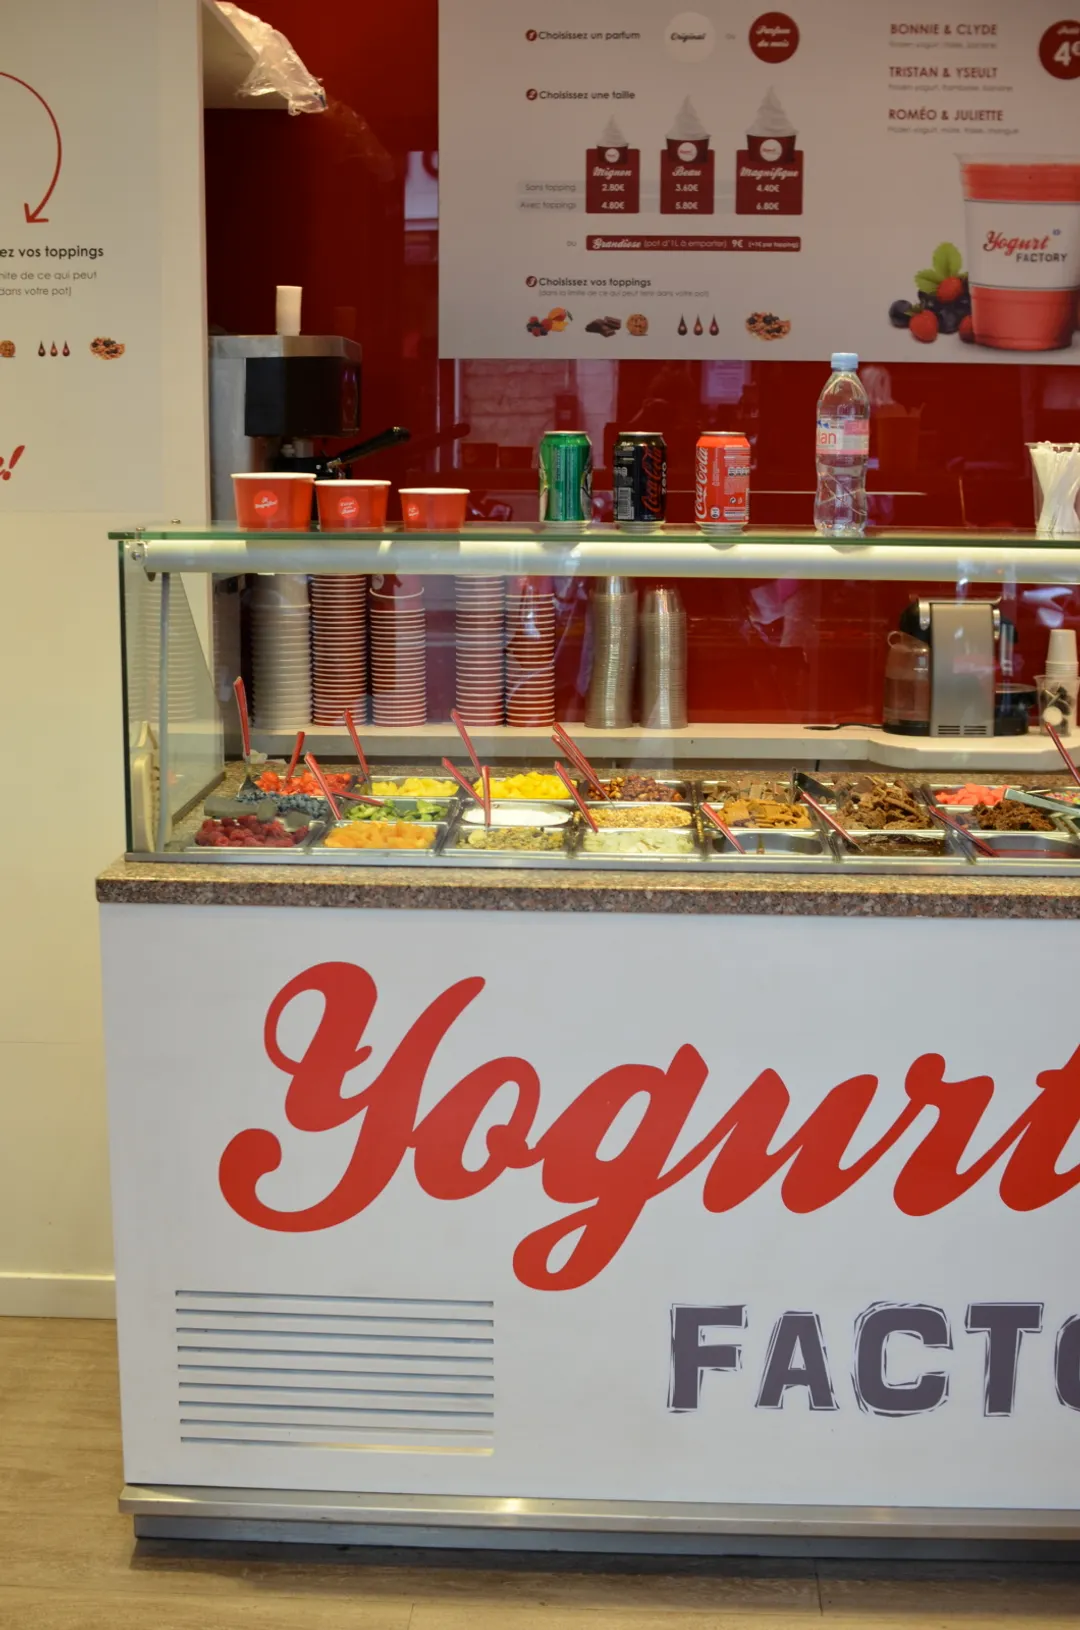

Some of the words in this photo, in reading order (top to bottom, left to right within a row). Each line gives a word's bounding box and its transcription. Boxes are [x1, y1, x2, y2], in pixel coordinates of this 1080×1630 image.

[890, 24, 940, 35] BONNIE
[944, 24, 952, 35] &
[956, 24, 998, 36] CLYDE
[538, 31, 588, 40] Choisissez
[590, 32, 603, 40] un
[605, 31, 640, 40] parfum
[670, 32, 706, 43] Original
[889, 66, 939, 78] TRISTAN
[942, 67, 951, 78] &
[956, 66, 998, 78] YSEULT
[538, 90, 588, 100] Choisissez
[590, 92, 610, 100] une
[612, 90, 636, 100] taille
[888, 106, 937, 120] ROMÉO
[941, 110, 949, 120] &
[954, 109, 1004, 120] JULIETTE
[592, 166, 633, 180] Mignon
[672, 166, 702, 176] Beau
[740, 166, 798, 180] Magnifique
[525, 184, 543, 192] Sans
[601, 183, 625, 192] 2.80€
[674, 184, 699, 192] 3.60€
[756, 184, 780, 193] 4.40€
[543, 201, 577, 210] toppings
[601, 201, 625, 210] 4.80€
[675, 201, 699, 210] 5.80€
[756, 202, 780, 210] 6.80€
[592, 238, 642, 250] Grandiose
[732, 239, 744, 248] 9€
[982, 229, 1050, 256] Yogurt
[18, 248, 42, 258] vos
[45, 245, 104, 260] toppings
[1016, 252, 1068, 262] FACTORY
[20, 270, 34, 280] de
[37, 271, 51, 280] ce
[54, 270, 70, 282] qui
[72, 271, 97, 282] peut
[538, 277, 587, 286] Choisissez
[609, 277, 652, 288] toppings
[24, 286, 49, 296] votre
[219, 961, 1080, 1291] Yogurt
[666, 1300, 1080, 1417] FACT
